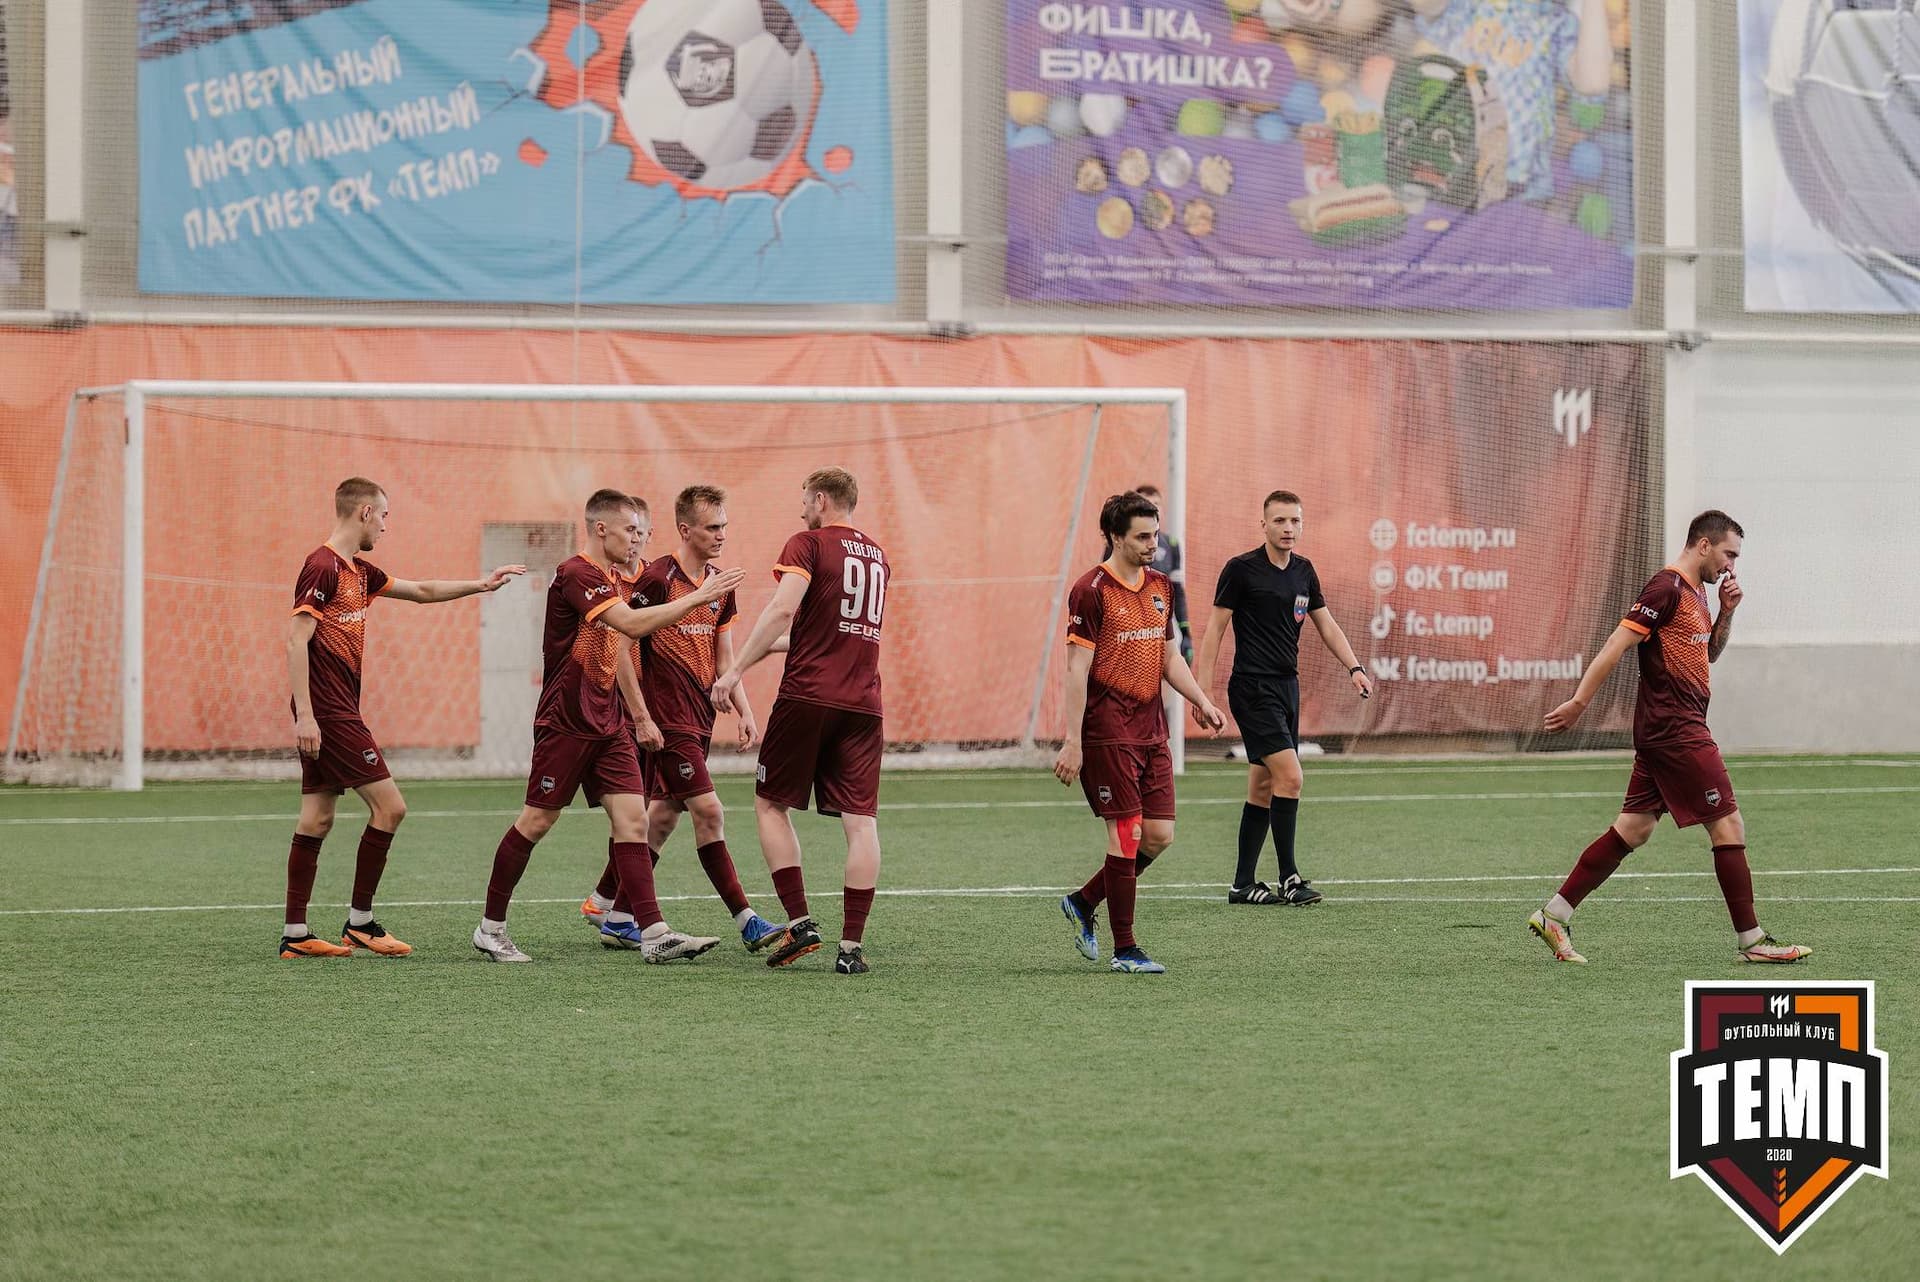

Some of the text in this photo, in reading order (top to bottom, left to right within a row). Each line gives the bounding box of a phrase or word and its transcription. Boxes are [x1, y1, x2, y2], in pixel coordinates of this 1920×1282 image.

[1039, 4, 1212, 47] ФИШКА,
[184, 35, 402, 121] ГЕНЕРАЛЬНЫЙ
[1040, 49, 1273, 88] БРАТИШКА?
[185, 80, 480, 188] ИНФОРМАЦИОННЫЙ
[184, 148, 501, 251] ПАРТНЕР ФК «ТЕМП»
[1406, 522, 1517, 553] fctemp.ru
[840, 556, 885, 624] 90
[1404, 565, 1508, 591] ФК Темп
[1405, 609, 1494, 640] fc.temp
[1406, 653, 1583, 687] fctemp_barnaul
